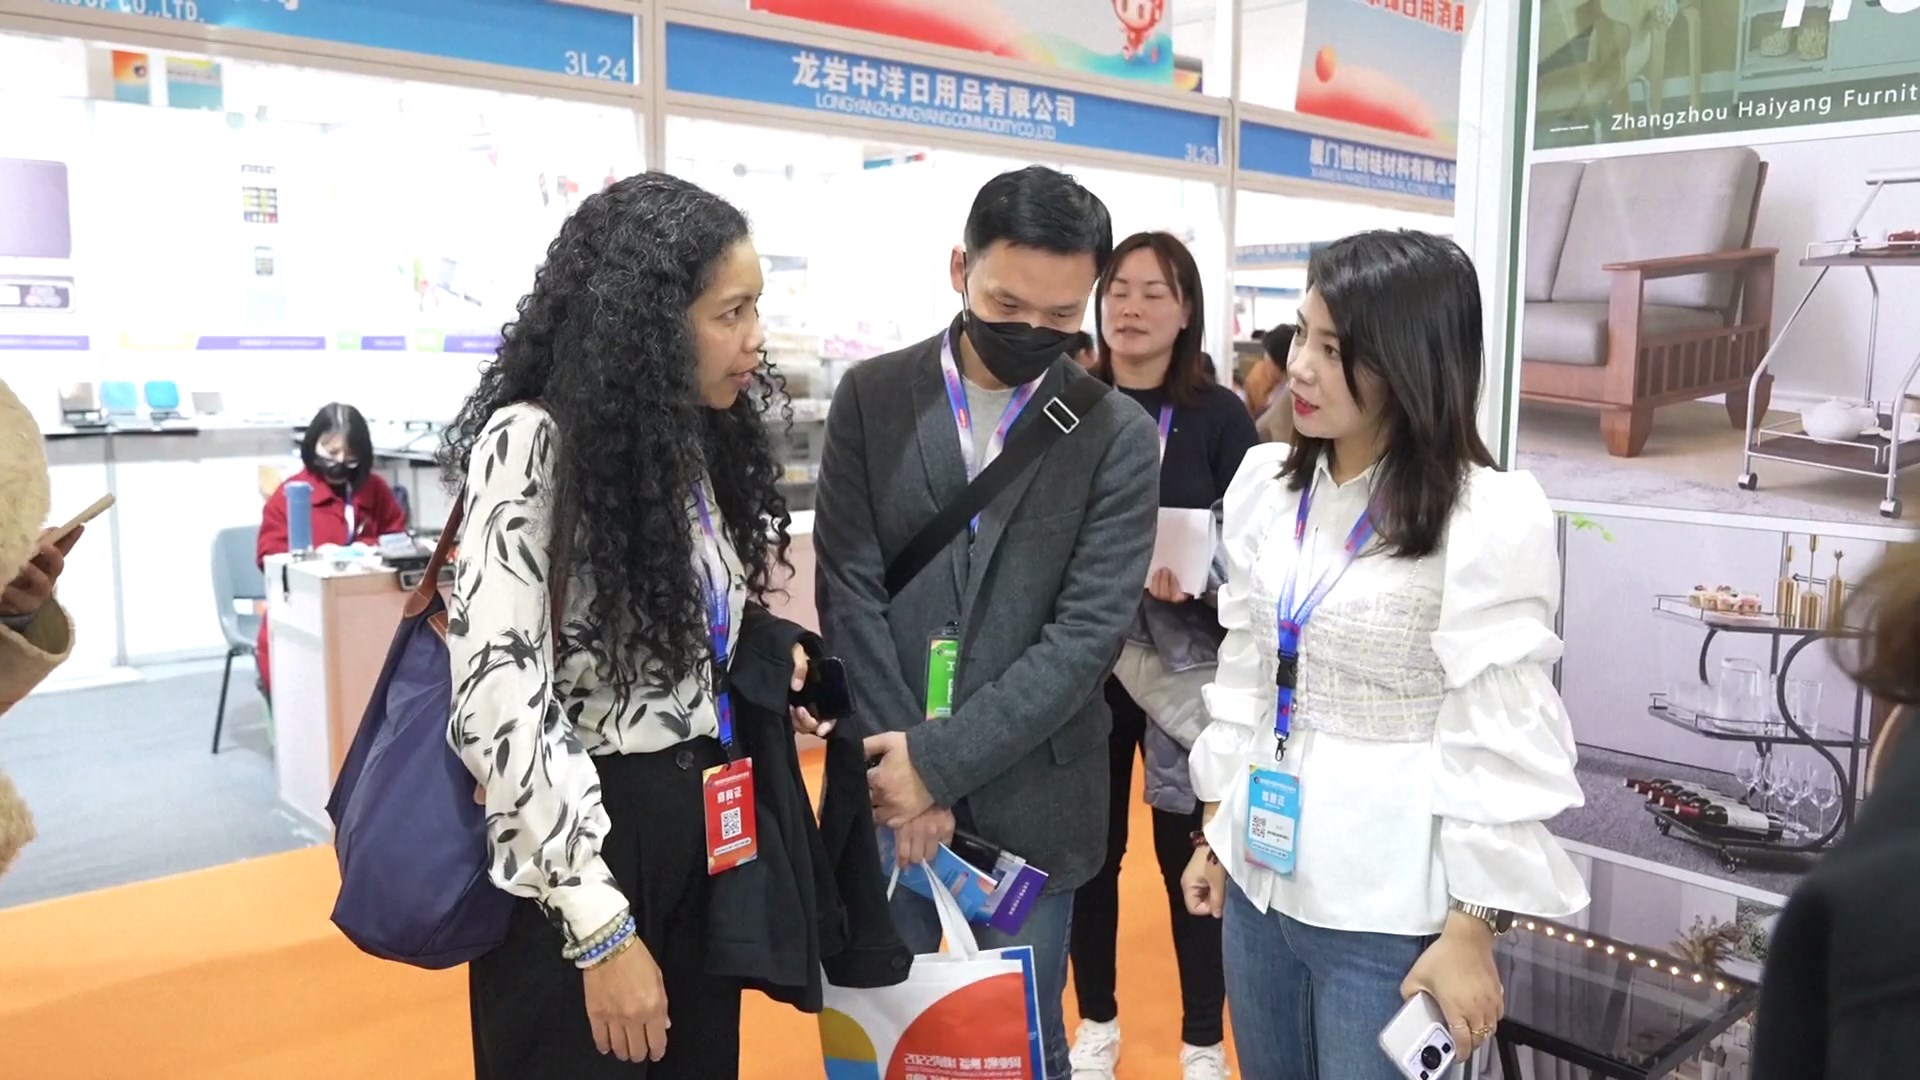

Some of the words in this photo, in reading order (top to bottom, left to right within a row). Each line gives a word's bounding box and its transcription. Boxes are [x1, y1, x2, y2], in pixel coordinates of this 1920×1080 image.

[564, 49, 627, 81] 3L24
[792, 50, 1077, 127] 龙岩中洋日用品有限公司
[1610, 105, 1728, 131] Zhangzhou
[1738, 96, 1832, 119] Haiyang
[1843, 83, 1919, 108] Furnit
